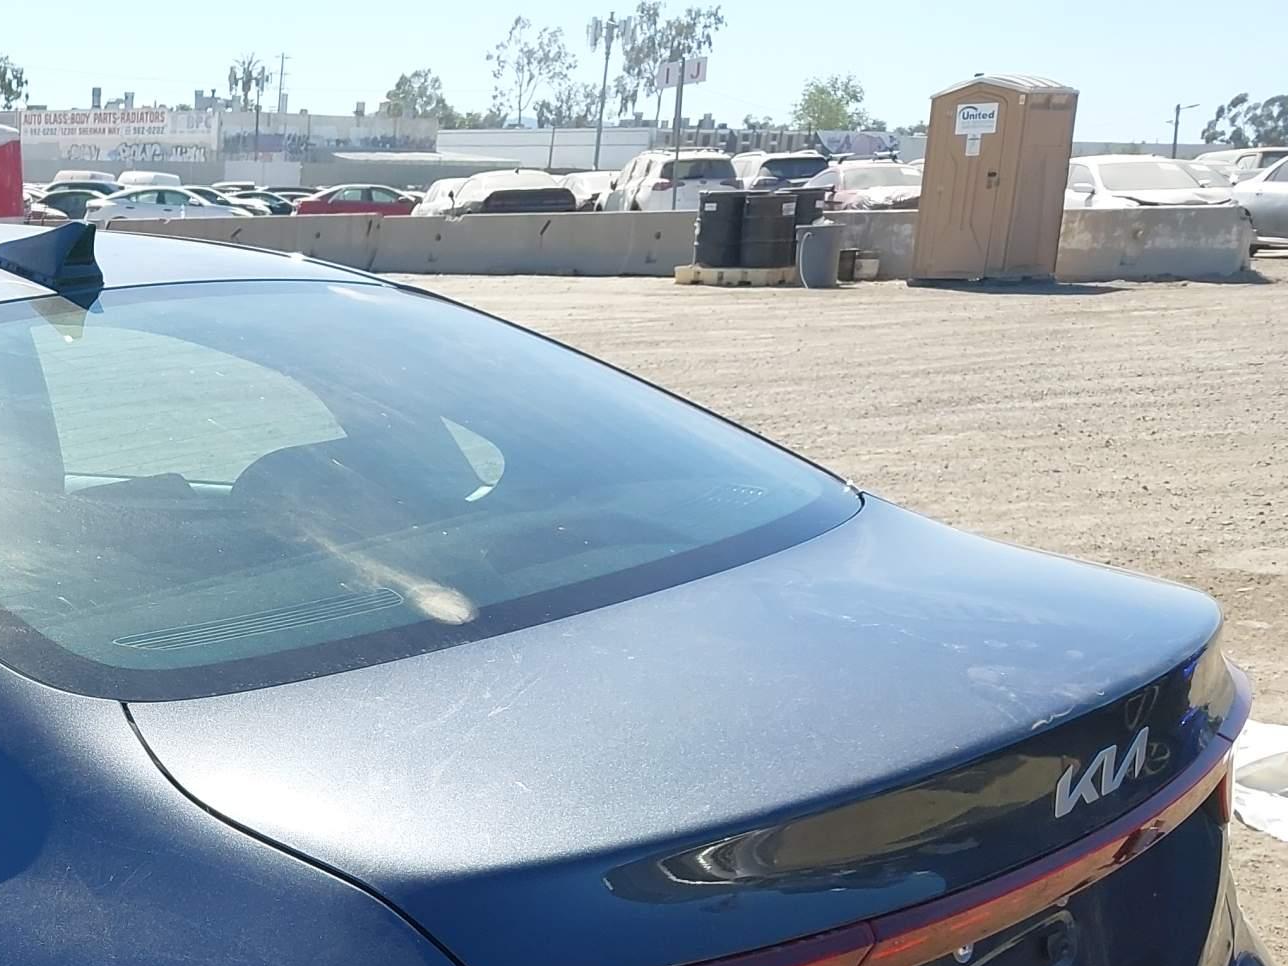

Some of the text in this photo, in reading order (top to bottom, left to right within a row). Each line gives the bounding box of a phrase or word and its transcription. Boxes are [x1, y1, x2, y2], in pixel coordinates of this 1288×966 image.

[690, 62, 701, 79] J
[23, 113, 42, 125] AUTO
[961, 110, 995, 120] United
[79, 127, 106, 136] SHERMAN
[107, 127, 120, 136] WAY
[1054, 725, 1150, 819] KIA
